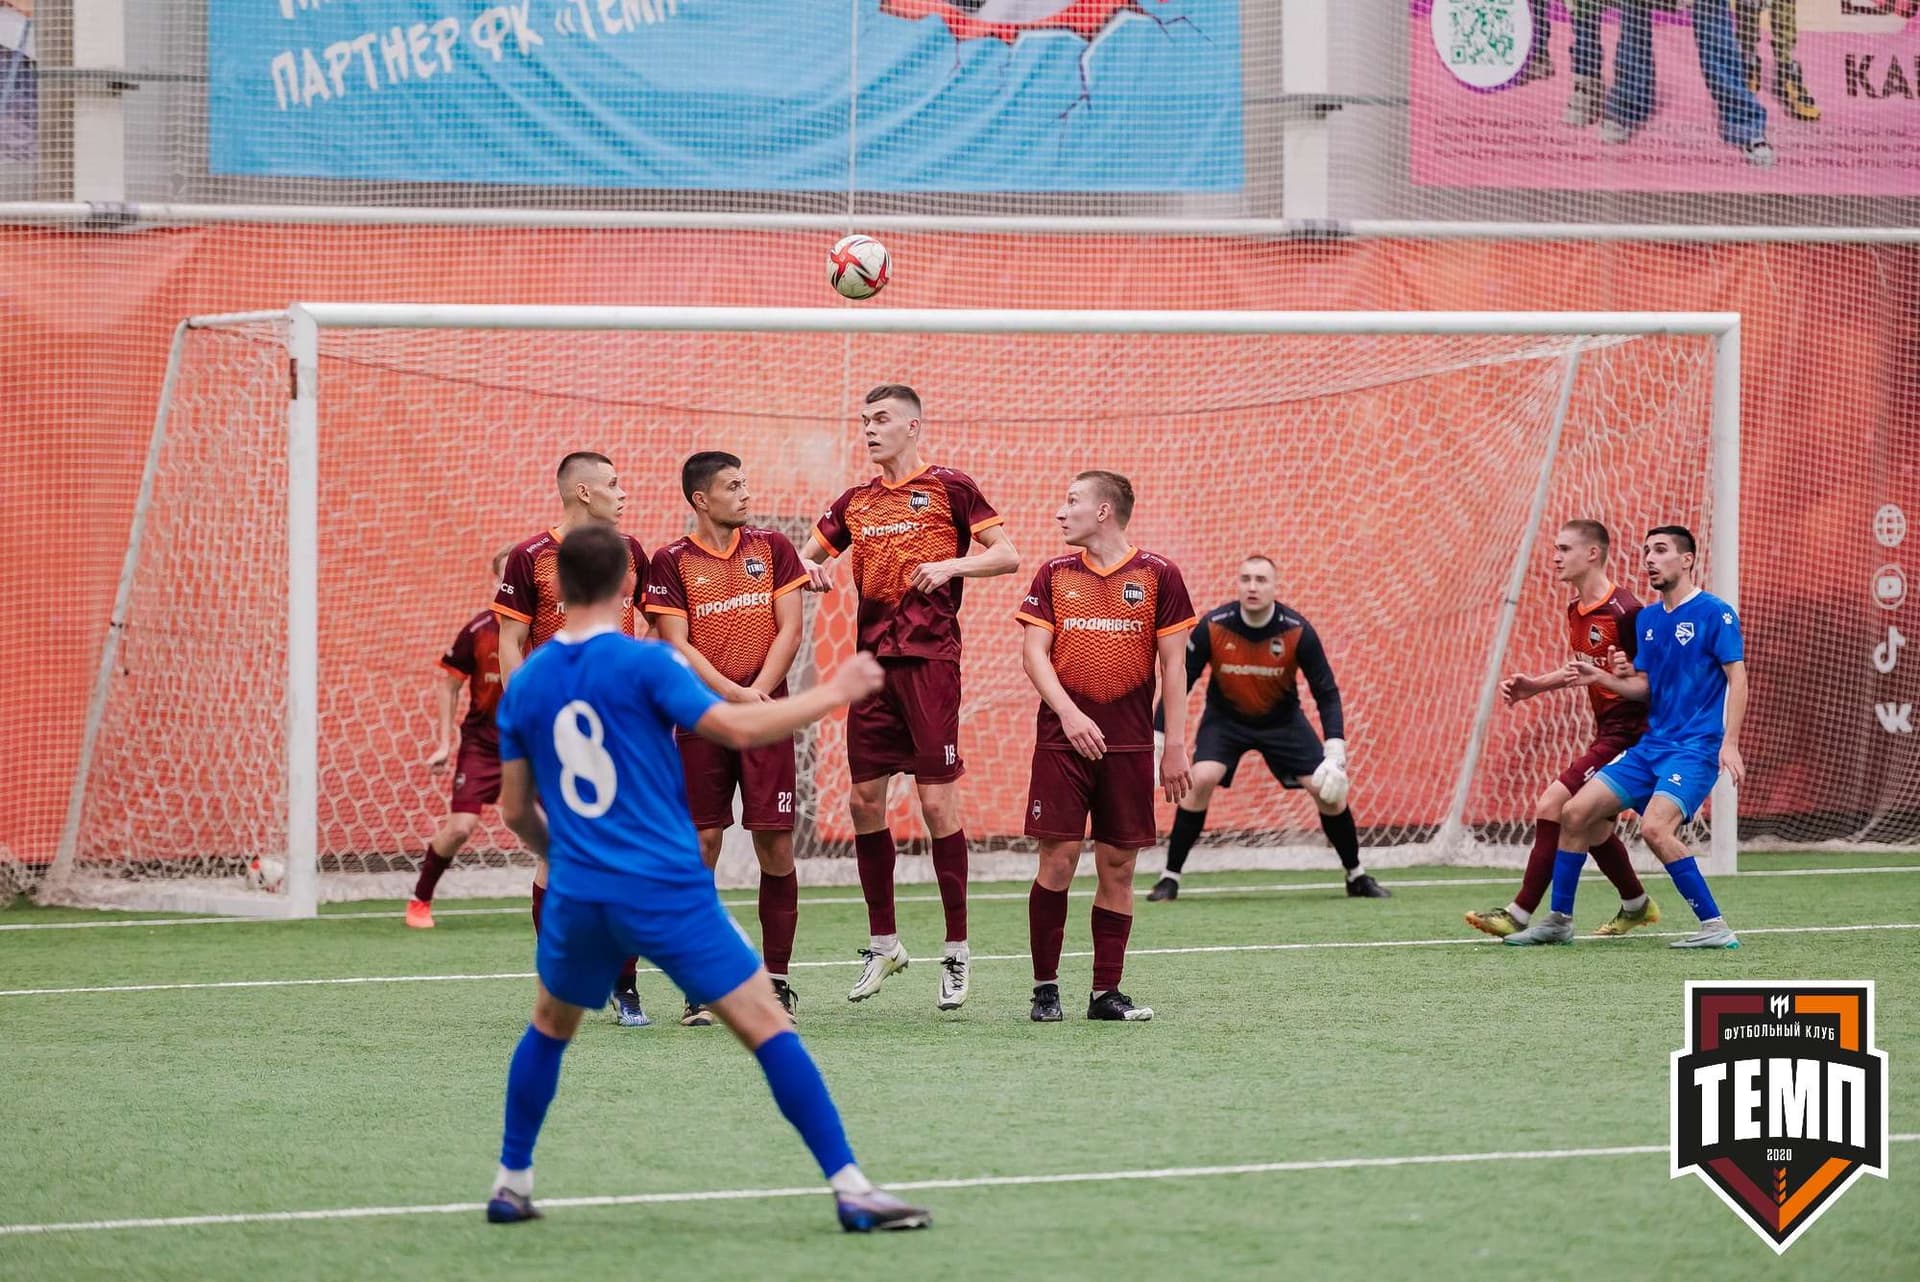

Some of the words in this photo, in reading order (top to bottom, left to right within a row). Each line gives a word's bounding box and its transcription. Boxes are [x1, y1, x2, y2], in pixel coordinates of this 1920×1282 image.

[271, 17, 460, 112] ПАРТНЕР
[471, 0, 544, 61] ФК
[647, 584, 668, 595] ПСБ
[695, 592, 771, 618] ПРОДИНВЕСТ
[1063, 617, 1144, 632] ПРОДИНВЕСТ
[554, 700, 617, 819] 8
[778, 791, 792, 813] 22
